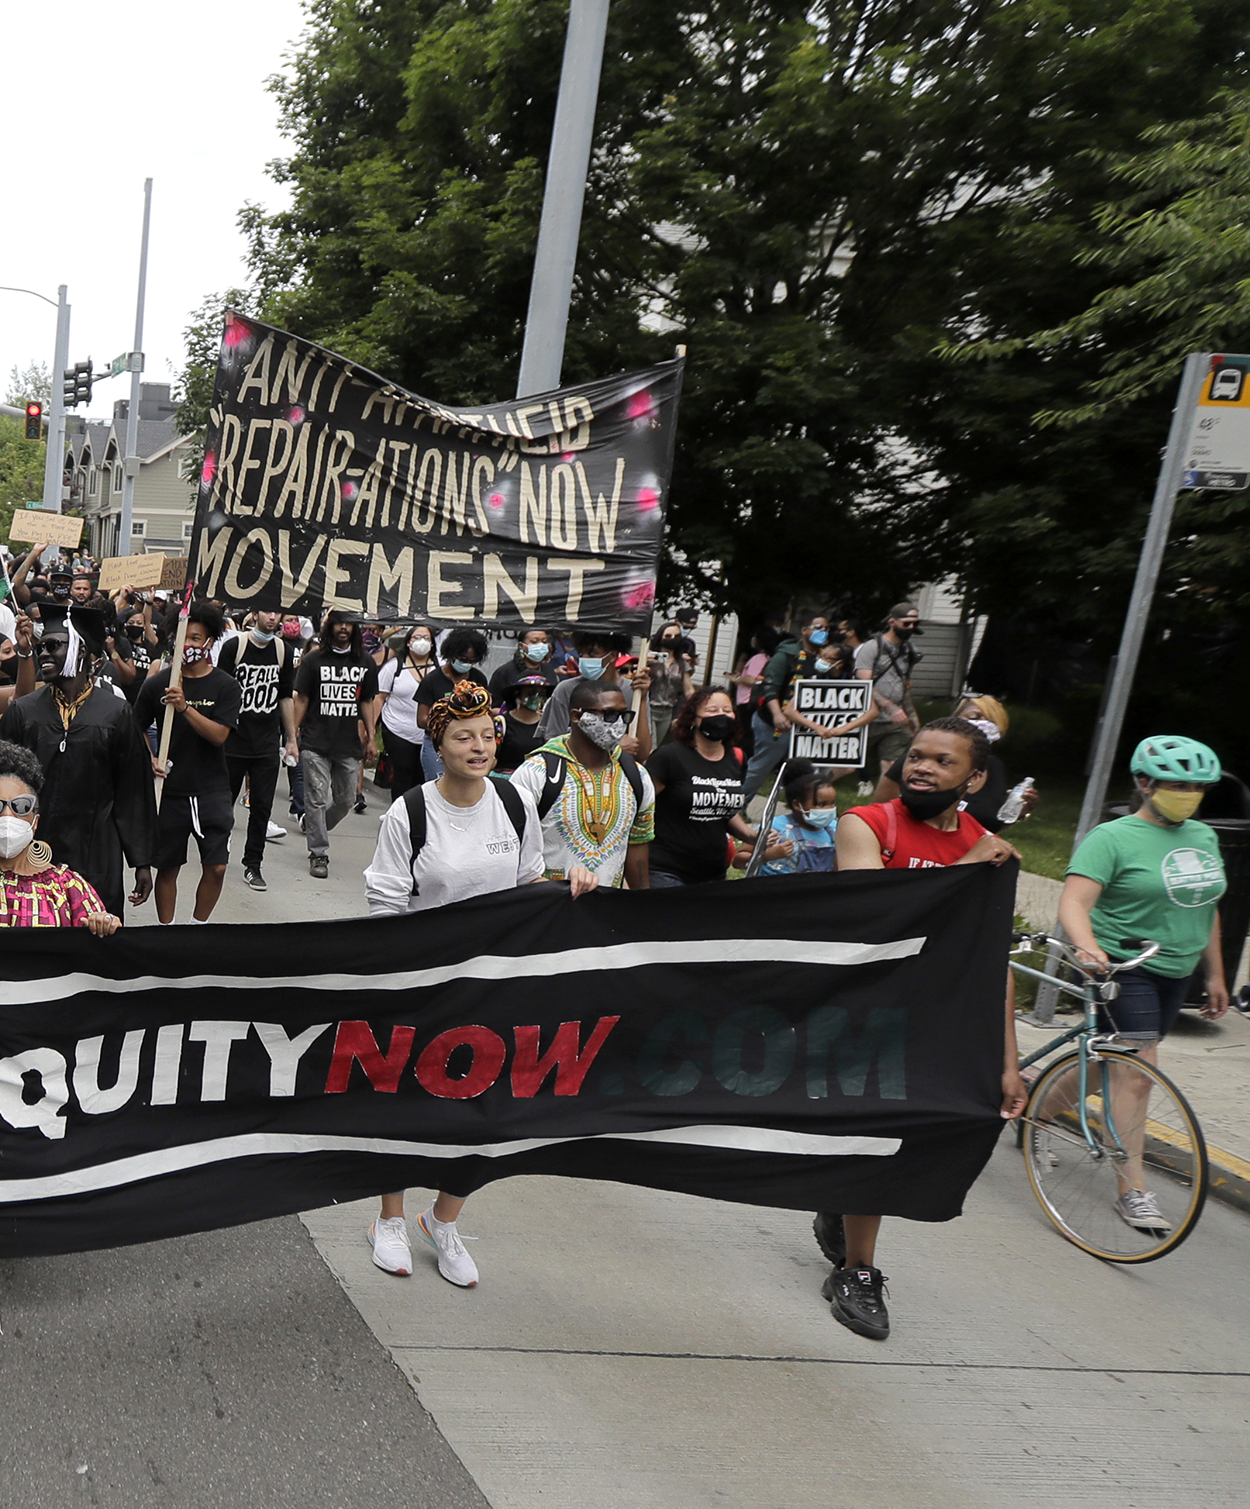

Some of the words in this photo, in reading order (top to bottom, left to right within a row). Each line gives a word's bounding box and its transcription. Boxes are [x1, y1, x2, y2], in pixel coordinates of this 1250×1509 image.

[519, 457, 626, 553] NOW
[195, 526, 605, 624] MOVEMENT
[320, 666, 368, 682] BLACK
[240, 684, 280, 713] OOD
[321, 685, 356, 699] LIVES
[800, 687, 865, 709] BLACK
[320, 703, 358, 717] MATTE
[796, 736, 860, 759] MATTER
[692, 792, 745, 808] MOVEMEN
